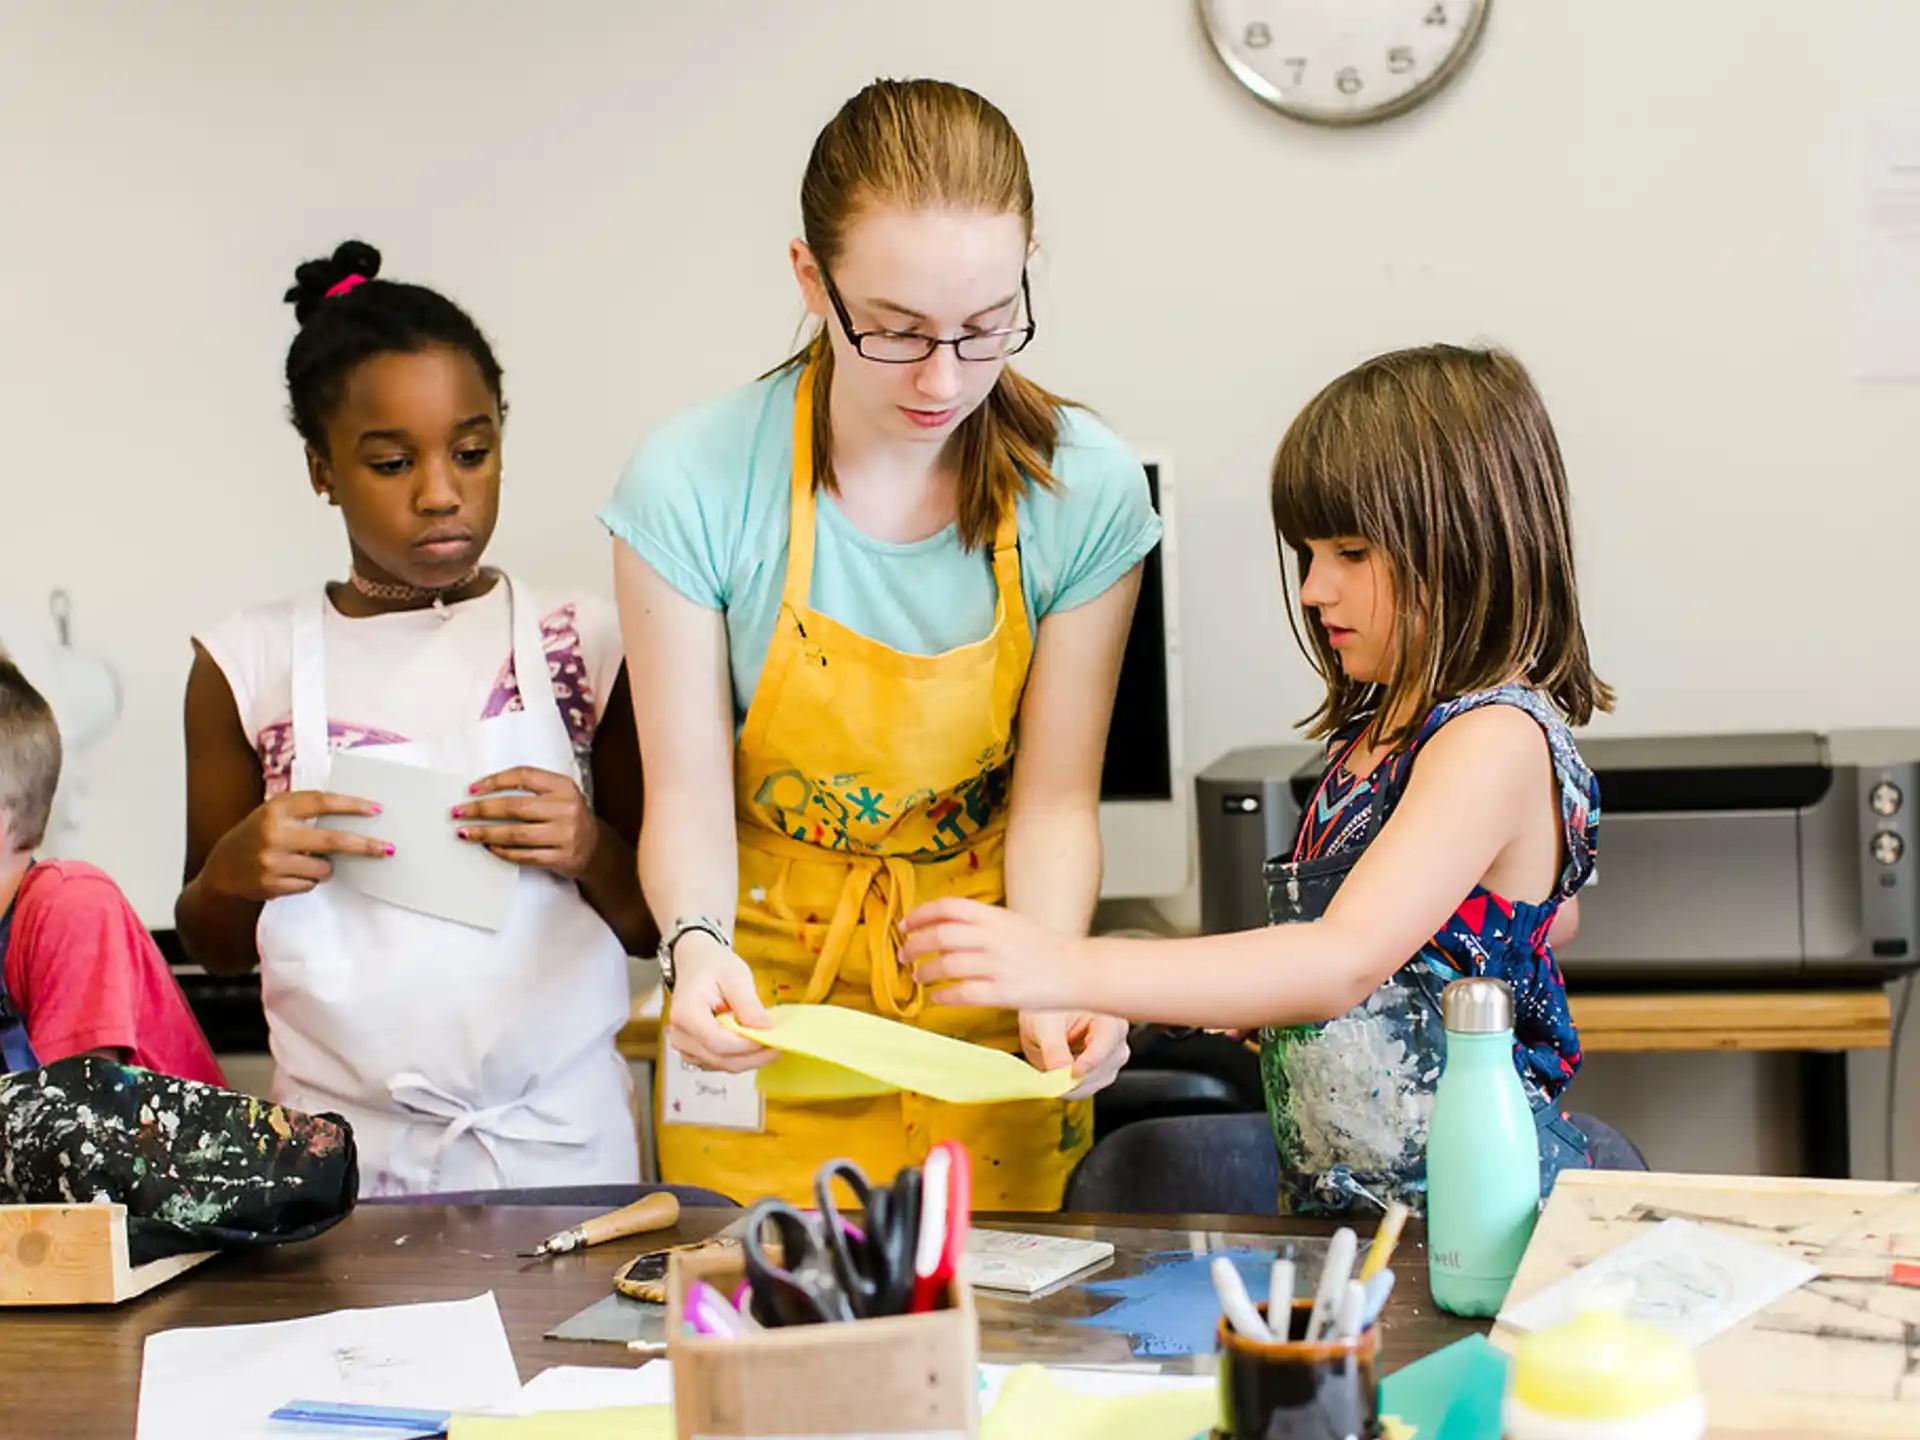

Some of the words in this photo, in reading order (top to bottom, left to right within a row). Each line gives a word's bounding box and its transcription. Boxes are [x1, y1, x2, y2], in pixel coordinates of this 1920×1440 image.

[1424, 1, 1448, 26] 4
[1244, 22, 1273, 49] 8
[1284, 57, 1307, 85] 7
[1387, 47, 1414, 74] 5
[1335, 66, 1363, 94] 6
